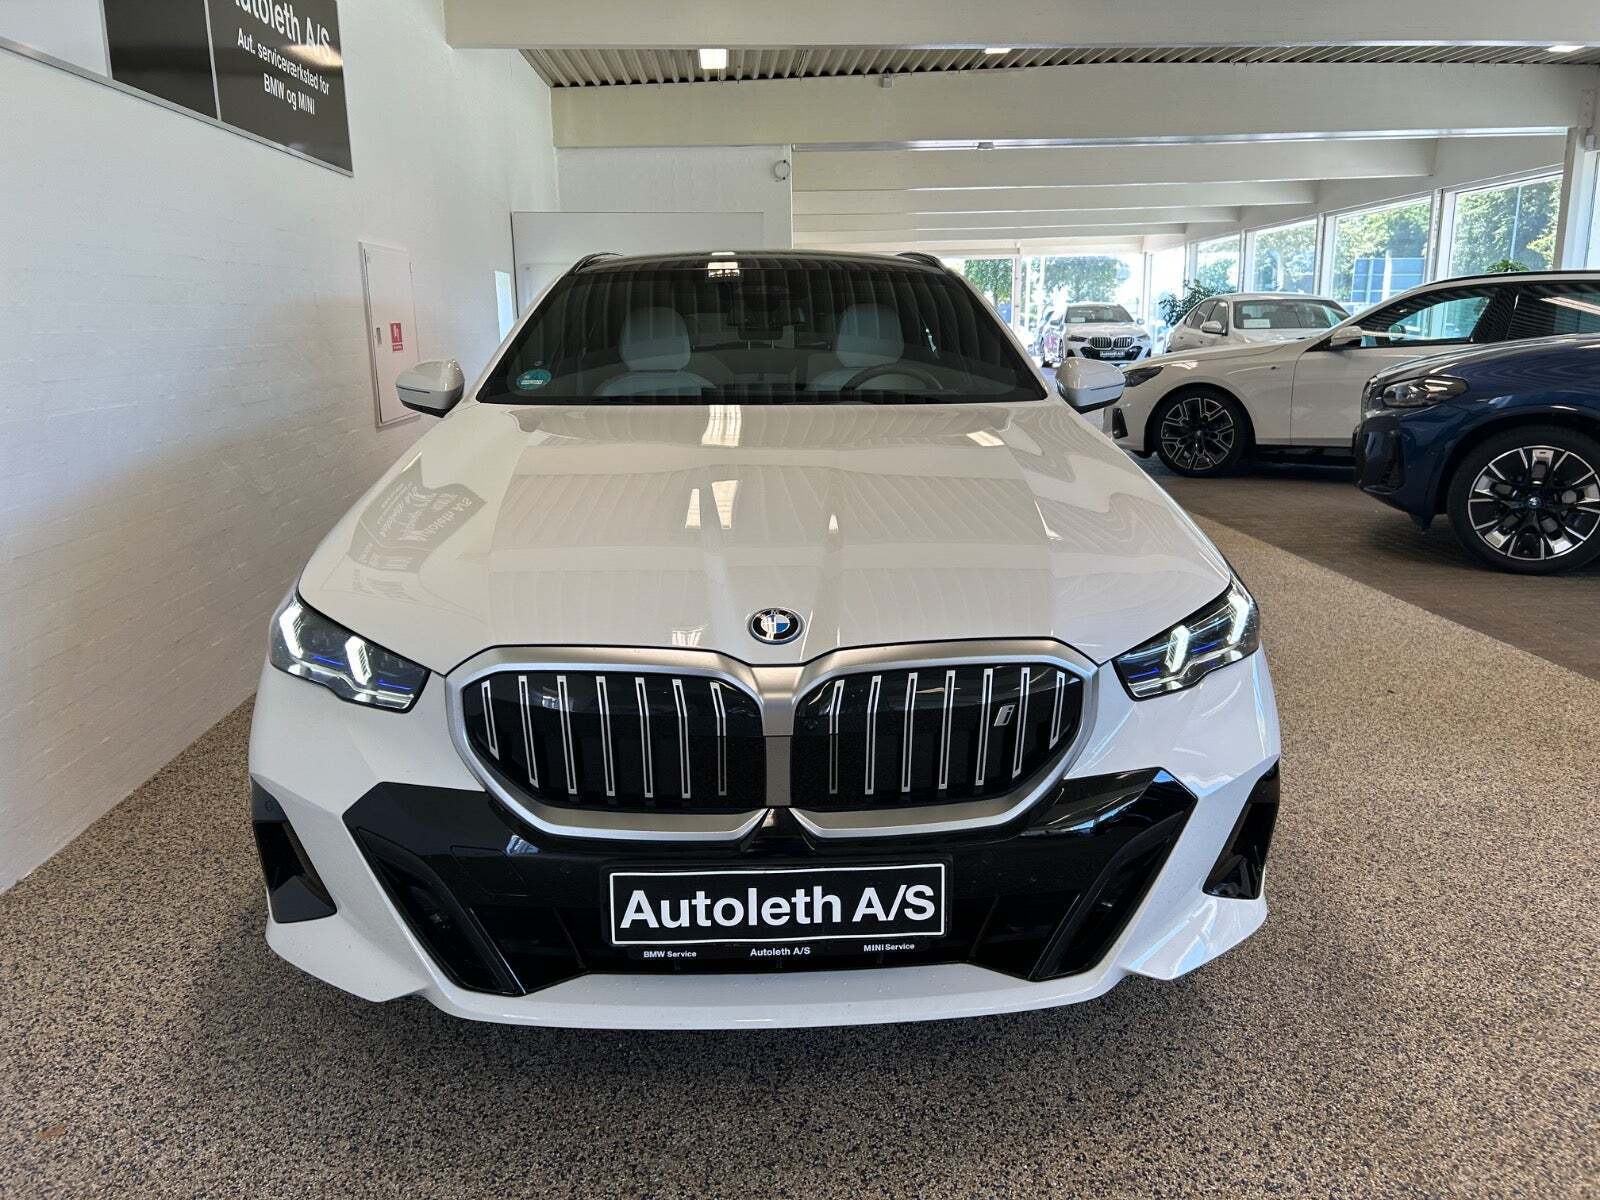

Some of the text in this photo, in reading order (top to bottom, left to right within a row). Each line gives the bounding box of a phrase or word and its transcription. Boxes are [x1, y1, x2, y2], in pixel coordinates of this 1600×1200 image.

[235, 0, 331, 61] utoleth A/S
[237, 27, 329, 95] Aut. serviceværksted for
[263, 73, 315, 115] BMW og MINI
[619, 884, 936, 929] Autoleth A/S
[643, 950, 697, 958] BMW Service
[750, 946, 811, 956] Autoleth A/S
[863, 943, 915, 952] MINI Service
